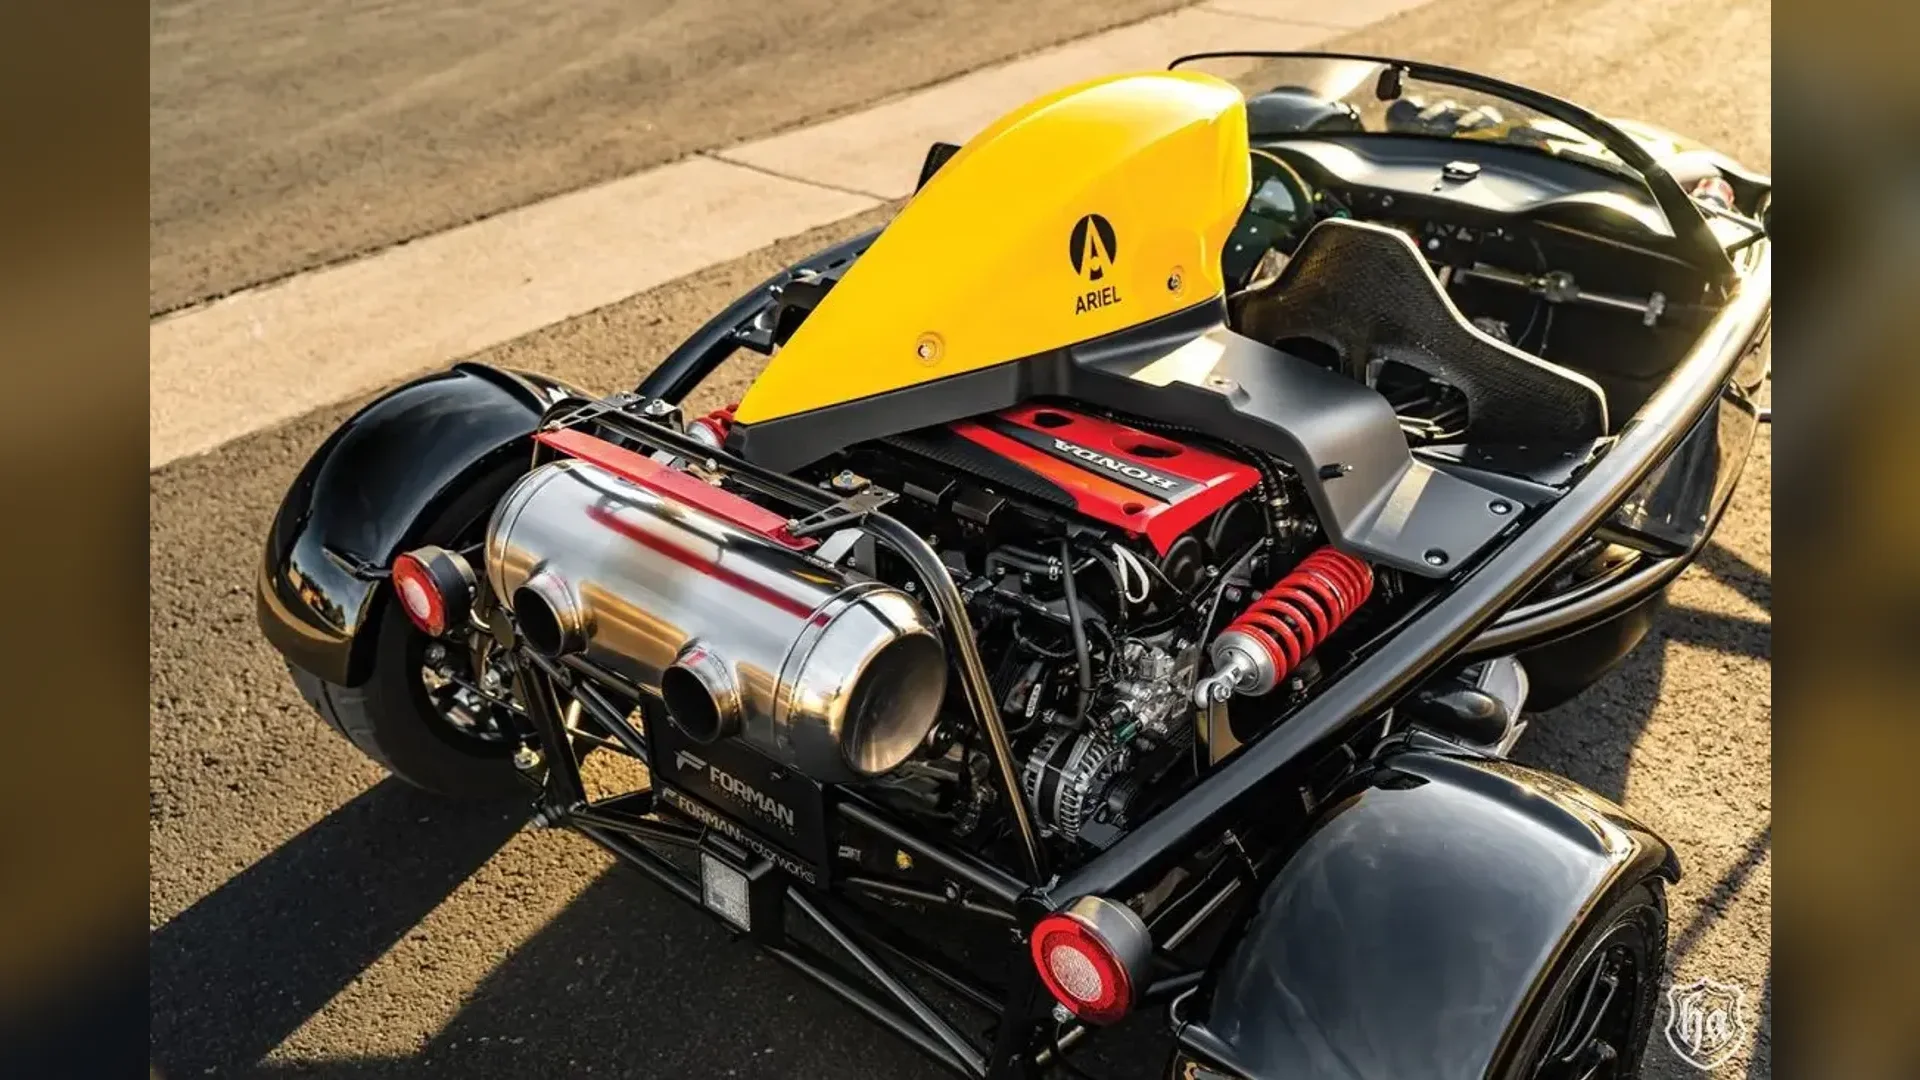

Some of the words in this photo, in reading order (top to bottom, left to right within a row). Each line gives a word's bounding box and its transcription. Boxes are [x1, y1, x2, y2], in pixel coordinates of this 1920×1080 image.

[1075, 286, 1122, 315] ARIEL
[1053, 438, 1178, 491] HONDA
[709, 764, 795, 827] FORMAN
